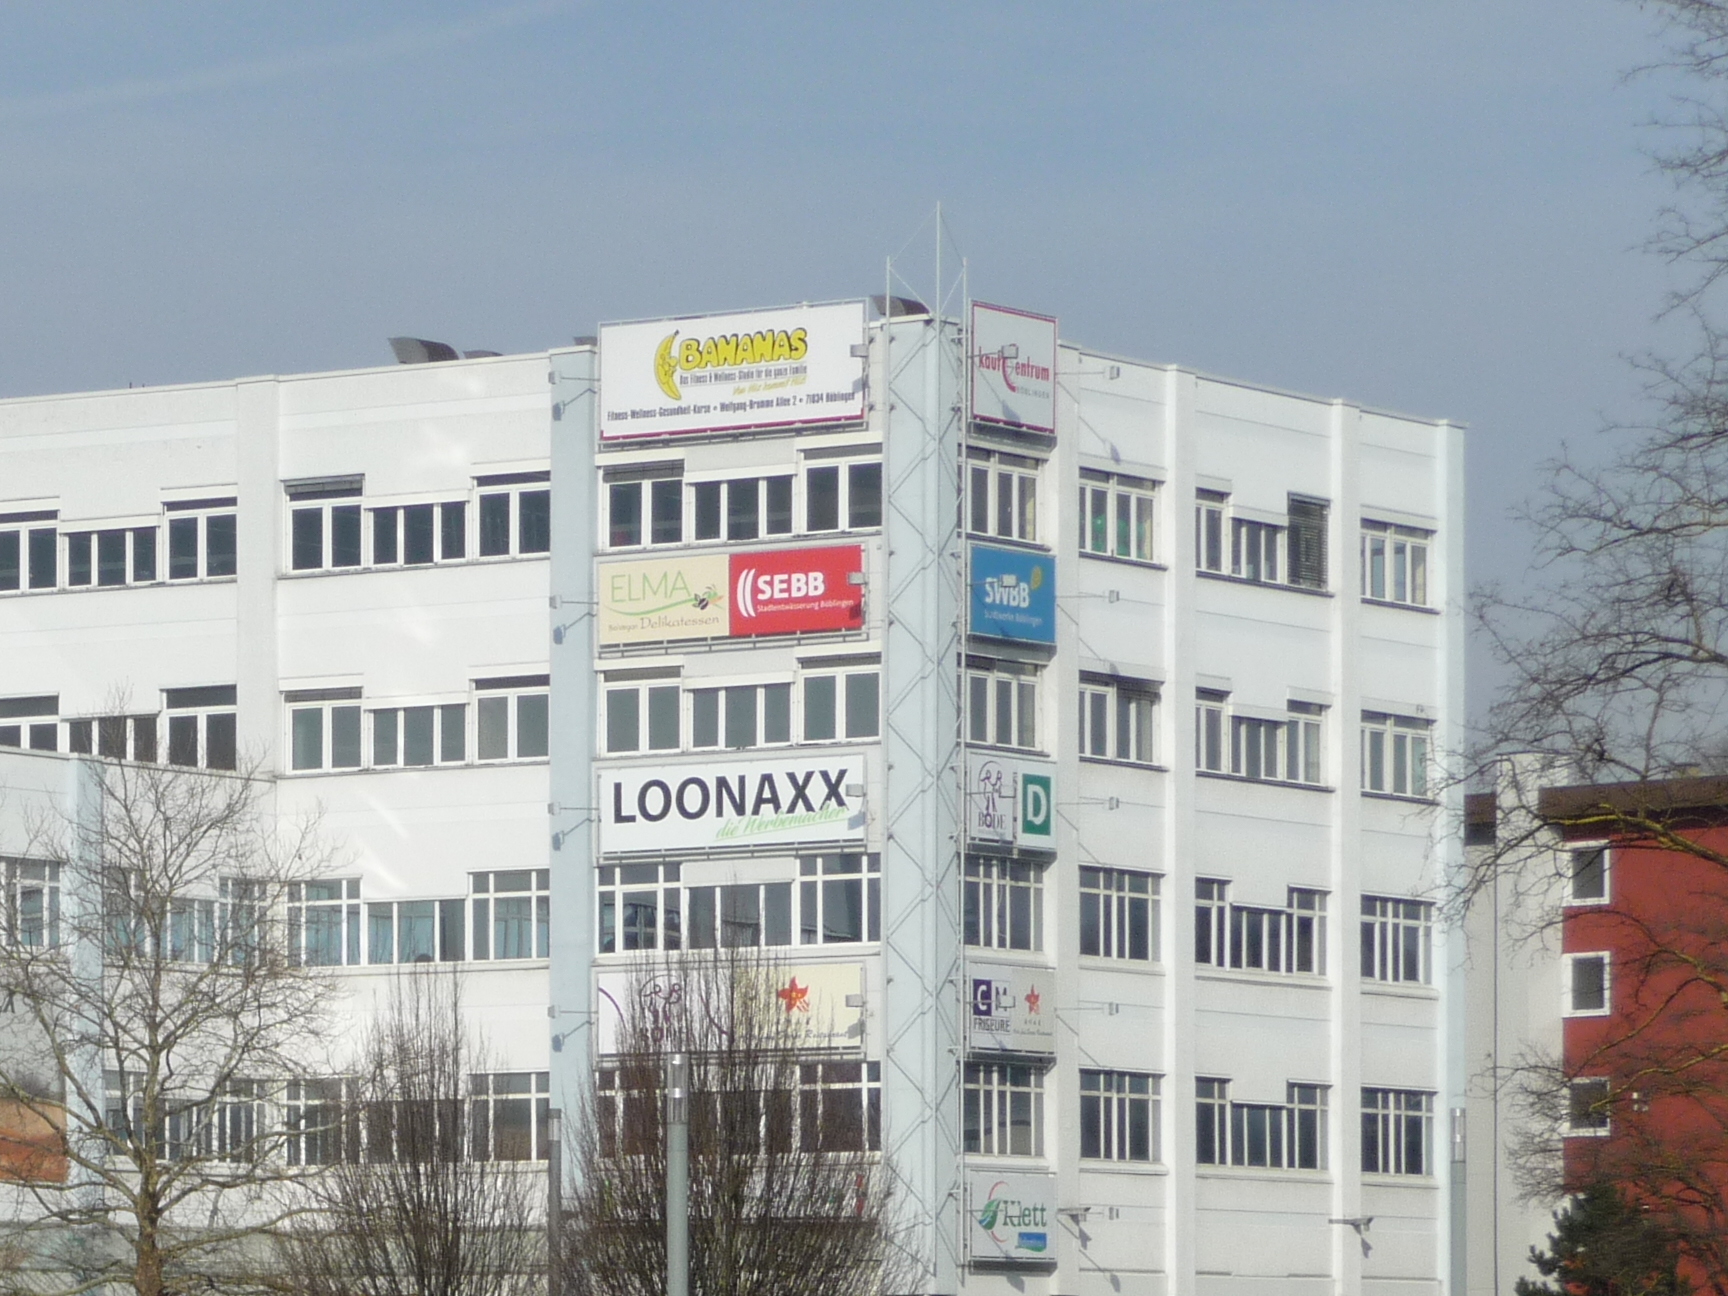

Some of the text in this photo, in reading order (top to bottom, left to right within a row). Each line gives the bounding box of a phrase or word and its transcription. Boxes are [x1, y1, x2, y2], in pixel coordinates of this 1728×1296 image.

[679, 327, 808, 370] BANANAS
[611, 570, 691, 602] ELMA
[757, 571, 825, 600] SEBB
[985, 577, 1030, 608] SWBB
[640, 615, 720, 630] Delikatessen
[613, 768, 849, 824] LOONAXX
[743, 800, 847, 833] Werbemacher
[978, 811, 1007, 830] BODE
[973, 1017, 1011, 1033] FRISEURE
